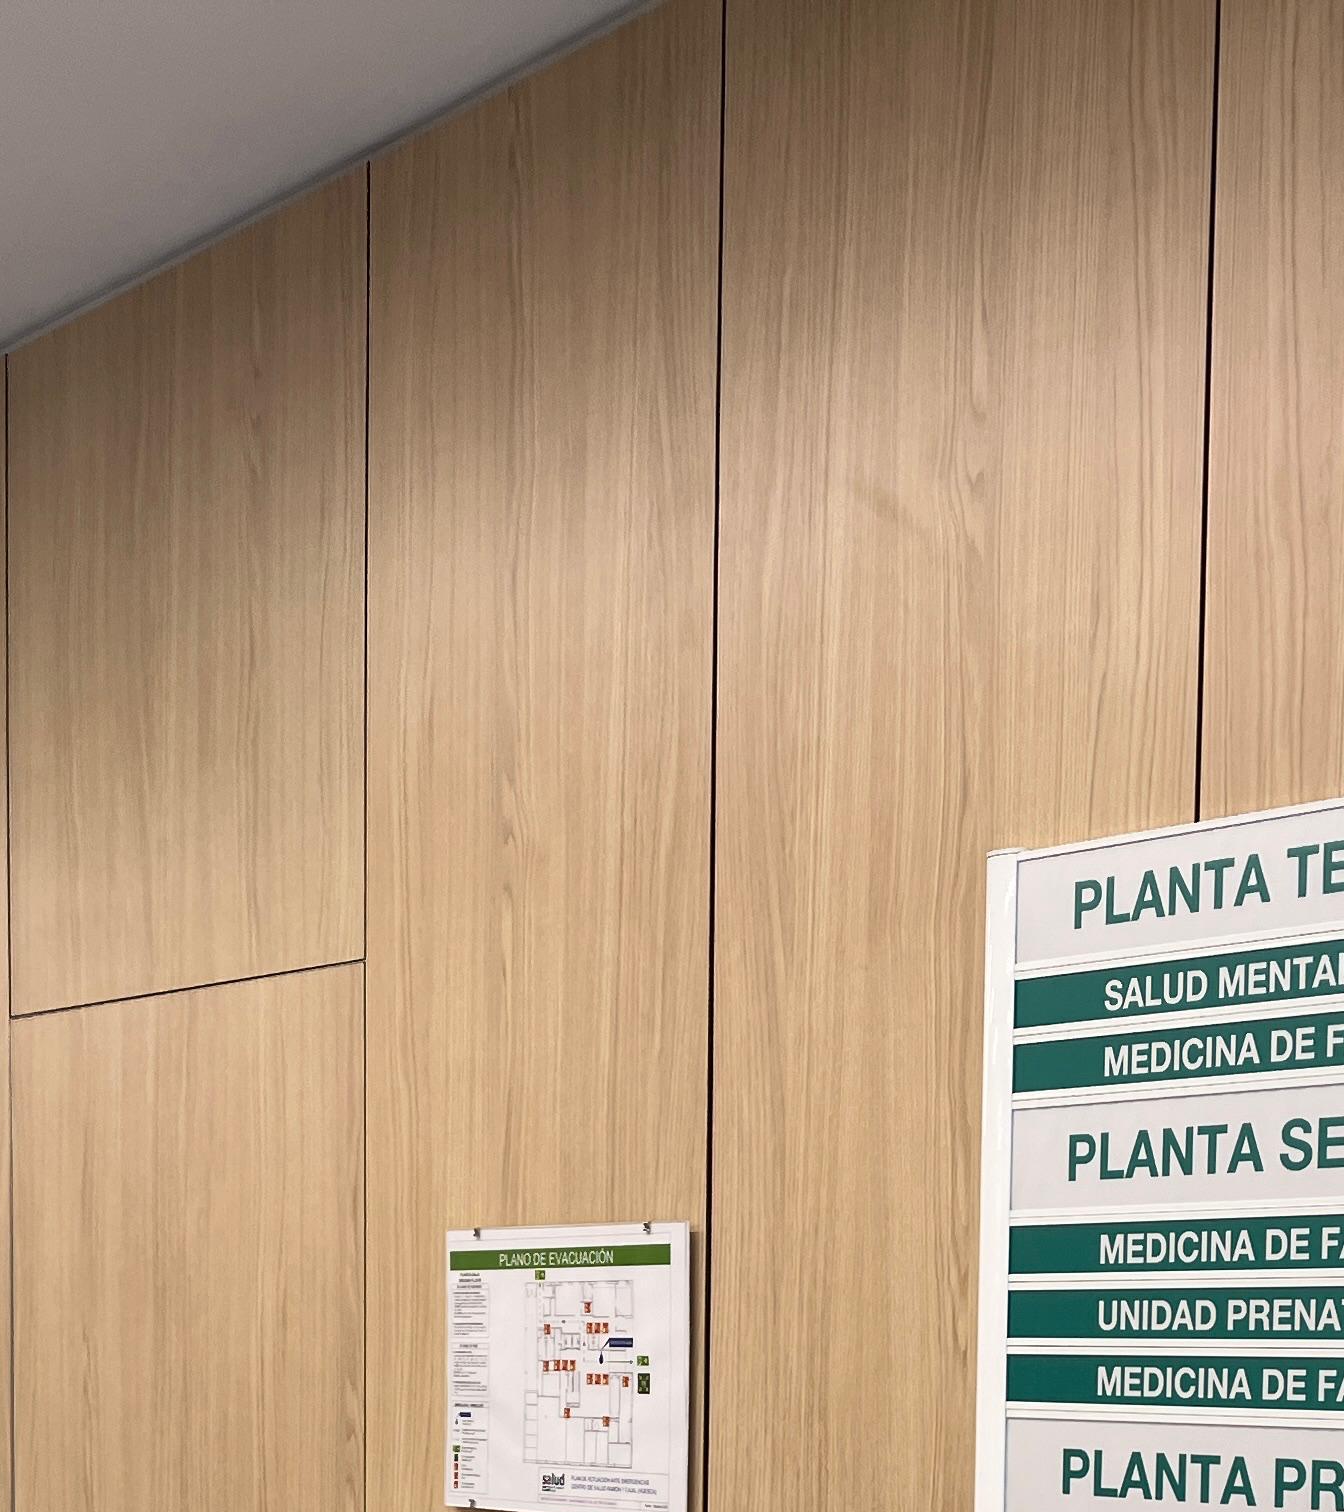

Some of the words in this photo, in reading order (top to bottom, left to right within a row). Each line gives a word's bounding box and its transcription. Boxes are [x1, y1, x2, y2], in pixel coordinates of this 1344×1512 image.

[1074, 854, 1270, 929] PLANTA
[1105, 970, 1207, 1011] SALUD
[1104, 1033, 1260, 1076] MEDICINA
[1271, 1027, 1315, 1062] DE
[1069, 1123, 1264, 1181] PLANTA
[499, 1253, 532, 1267] PLANO
[533, 1252, 547, 1266] DE
[549, 1248, 614, 1266] EVACUACIÓN
[1100, 1230, 1255, 1264] MEDICINA
[1266, 1228, 1309, 1260] DE
[1099, 1300, 1216, 1330] UNIDAD
[1098, 1367, 1251, 1399] MEDICINA
[1262, 1369, 1306, 1400] DE
[1063, 1449, 1256, 1506] PLANTA
